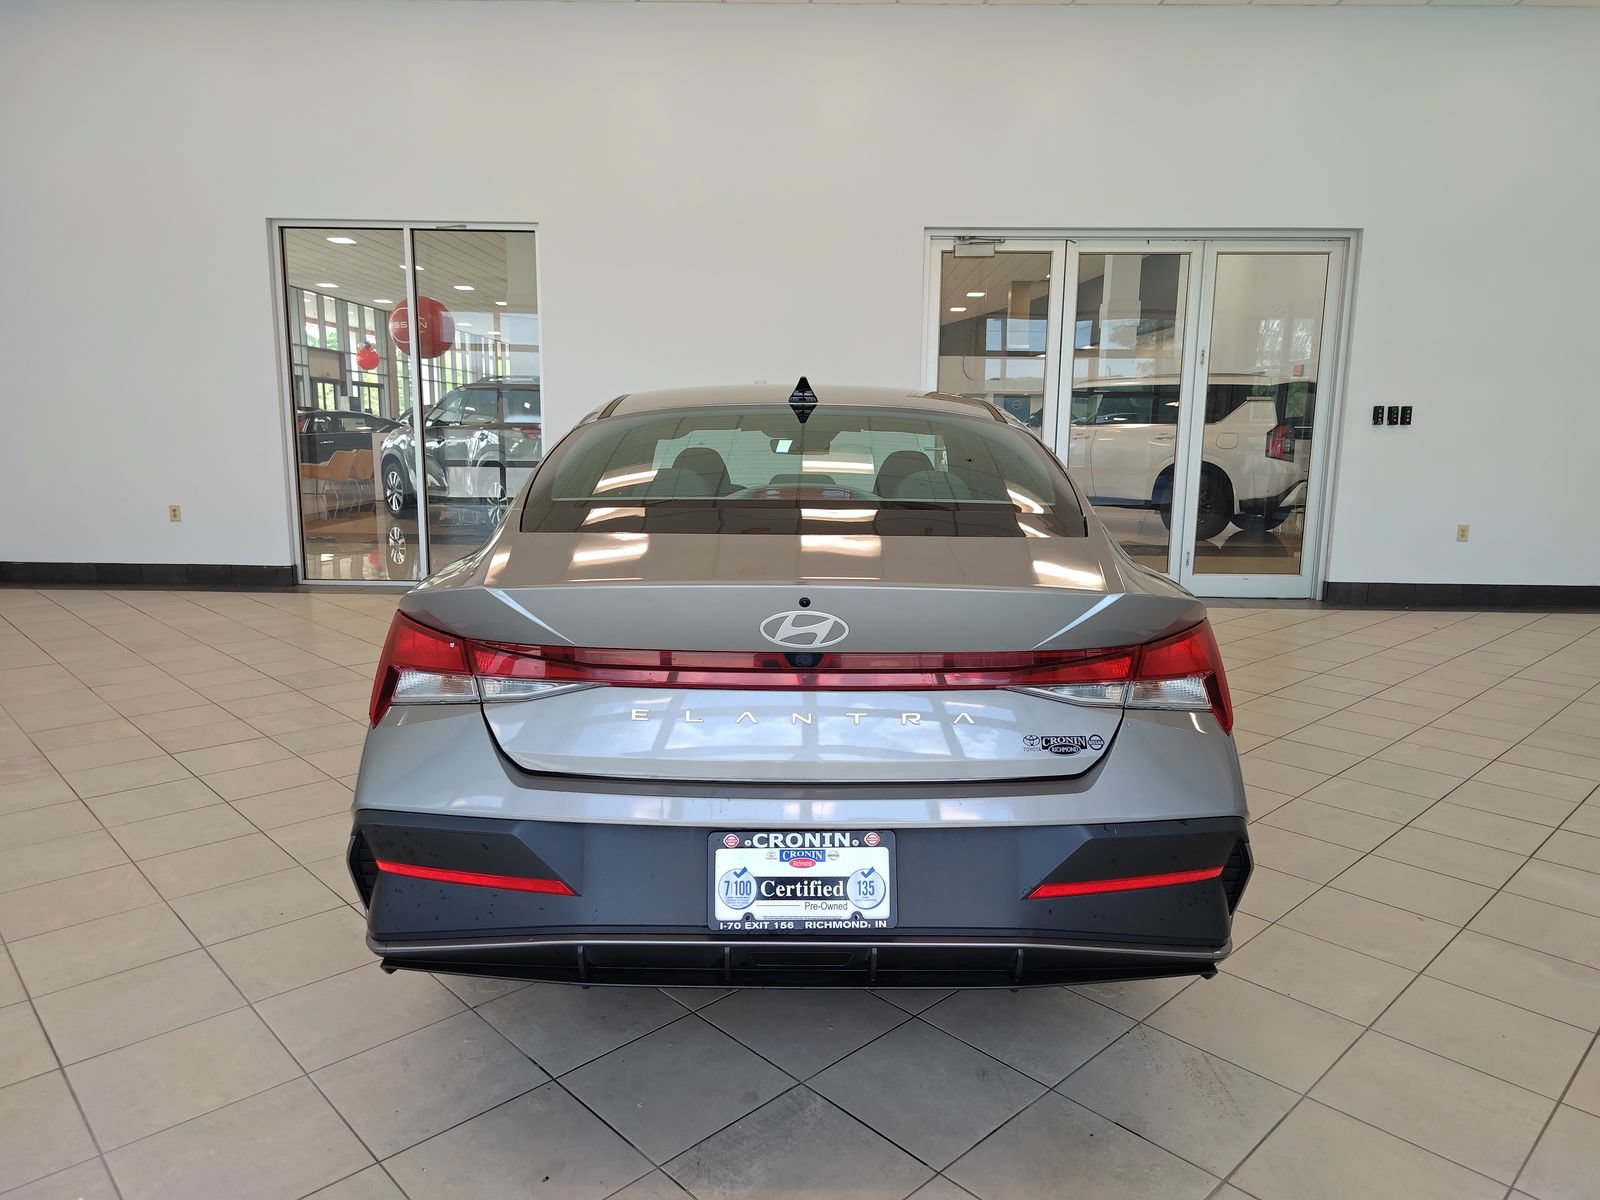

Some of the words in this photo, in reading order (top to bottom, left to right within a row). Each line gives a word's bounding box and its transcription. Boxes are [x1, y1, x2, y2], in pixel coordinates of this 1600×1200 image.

[631, 708, 975, 725] ELANTRA
[1042, 736, 1086, 747] CRONIN
[752, 832, 850, 848] CRONIN
[782, 850, 823, 861] CRONIN
[760, 880, 844, 897] Certified
[857, 880, 875, 896] 135
[804, 901, 848, 911] Pre-Owned
[720, 922, 741, 930] I-70
[744, 921, 769, 929] EXIT
[774, 921, 794, 929] 156
[805, 920, 871, 929] RICHMOND,
[875, 920, 887, 928] IN
